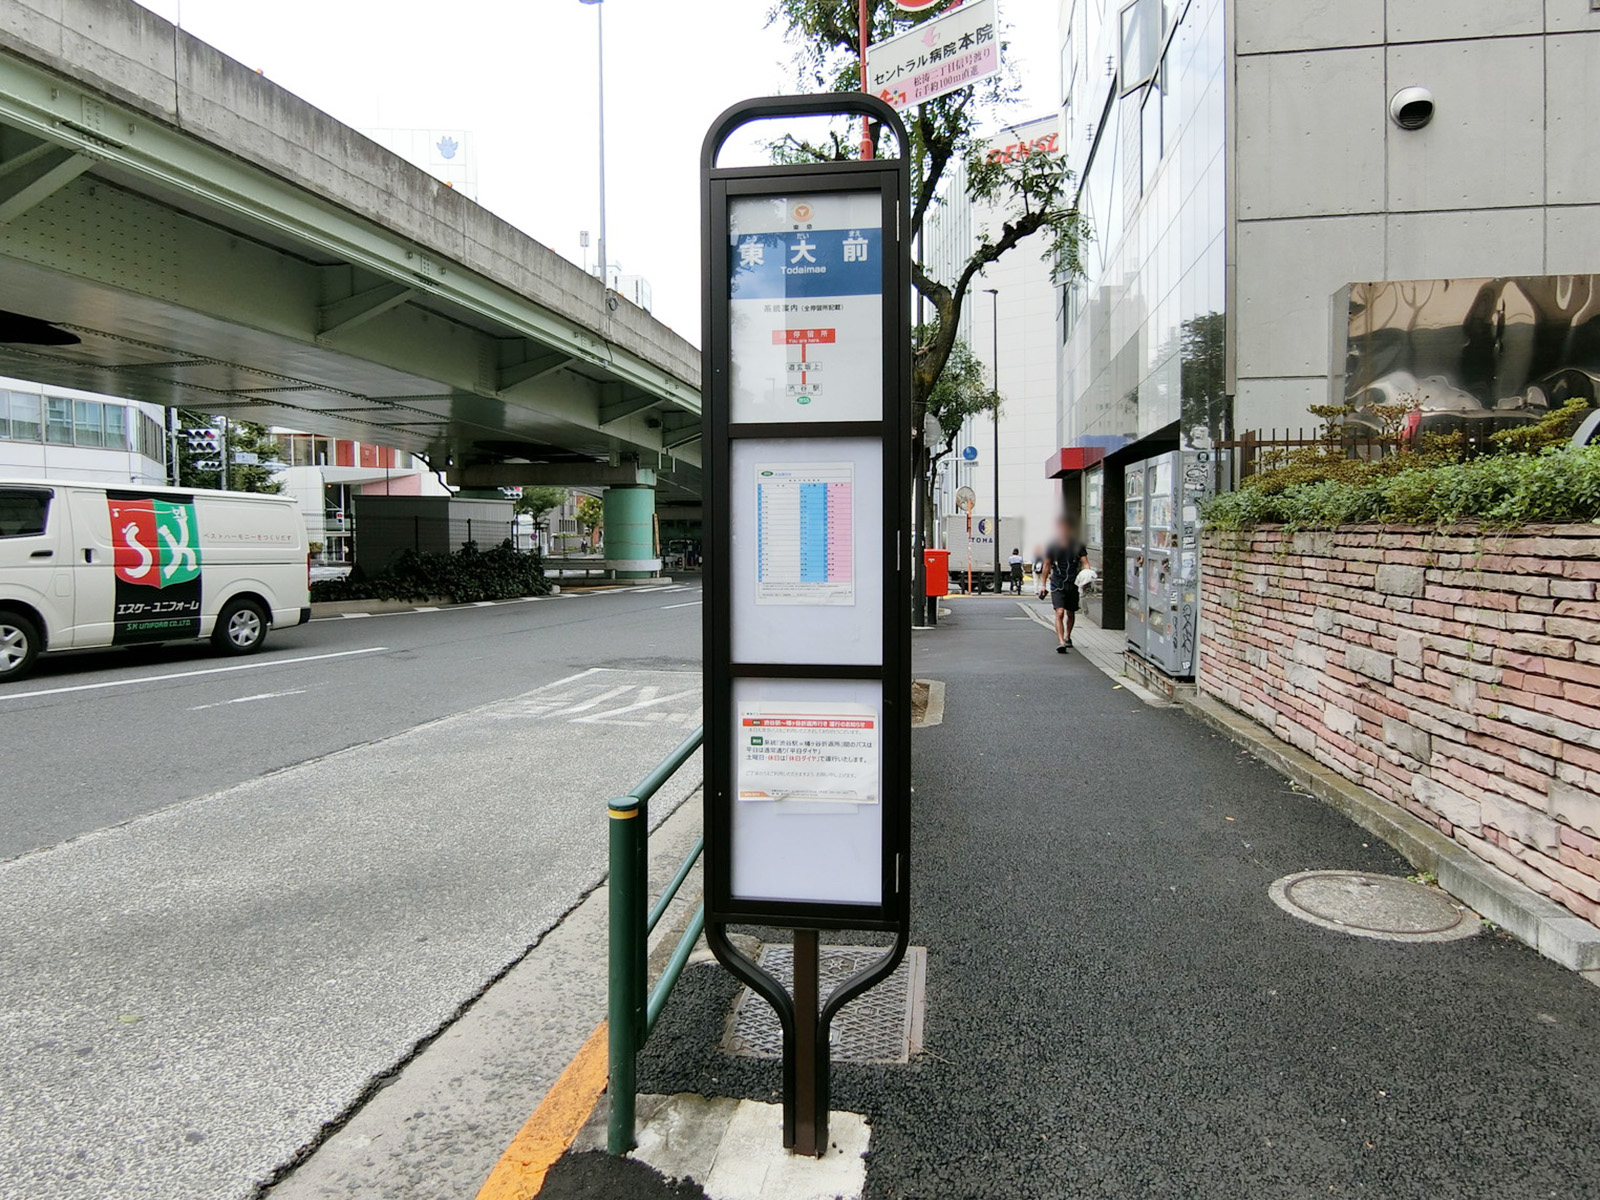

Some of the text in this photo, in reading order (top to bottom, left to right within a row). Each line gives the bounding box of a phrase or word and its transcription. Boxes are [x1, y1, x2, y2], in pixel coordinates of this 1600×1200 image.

[874, 23, 994, 85] セントラル病院本院
[914, 65, 979, 98] 右手約100m直進
[739, 238, 869, 266] 東大前
[780, 266, 827, 275] Todaimae
[203, 532, 292, 542] ベストハーモニーをつくりだす
